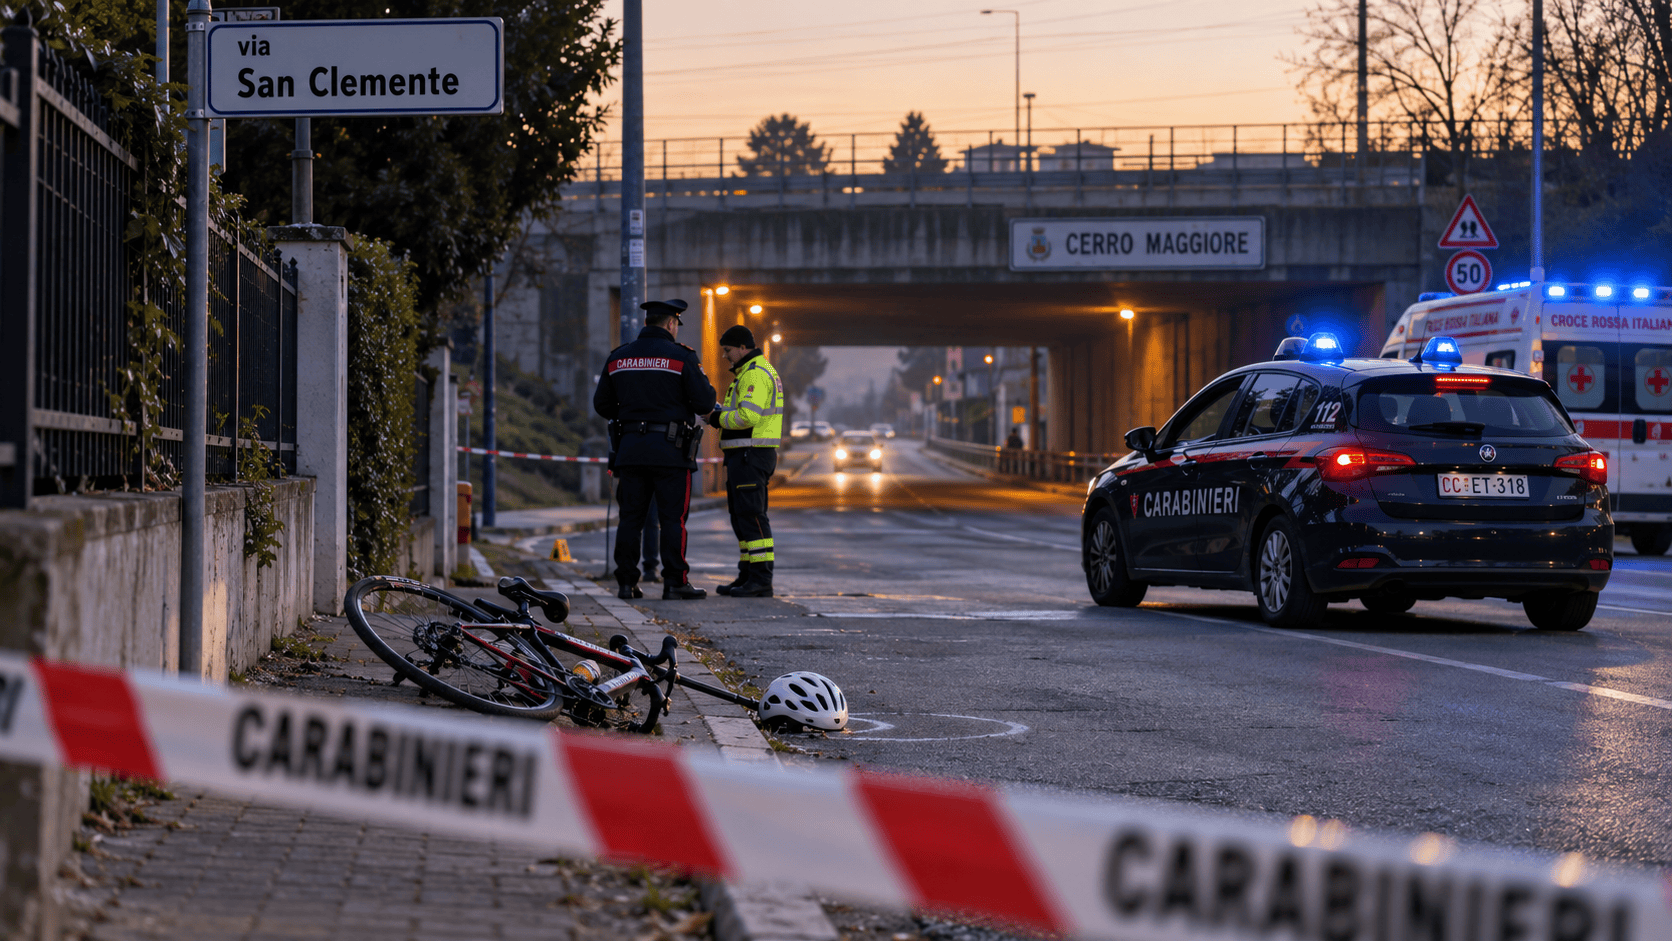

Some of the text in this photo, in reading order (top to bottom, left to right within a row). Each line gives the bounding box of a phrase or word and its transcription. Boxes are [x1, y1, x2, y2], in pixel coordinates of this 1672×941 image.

[237, 34, 271, 56] via
[237, 66, 459, 98] San Clemente
[1066, 231, 1249, 255] CERRO MAGGIORE
[1456, 263, 1482, 284] 50
[1551, 314, 1588, 328] CROCE
[1592, 315, 1629, 329] ROSSA
[616, 358, 670, 369] CARABINIERI
[1314, 401, 1342, 423] 112
[1442, 477, 1461, 493] CC
[1144, 486, 1240, 518] CARABINIERI
[232, 703, 538, 819] CARABINIERI
